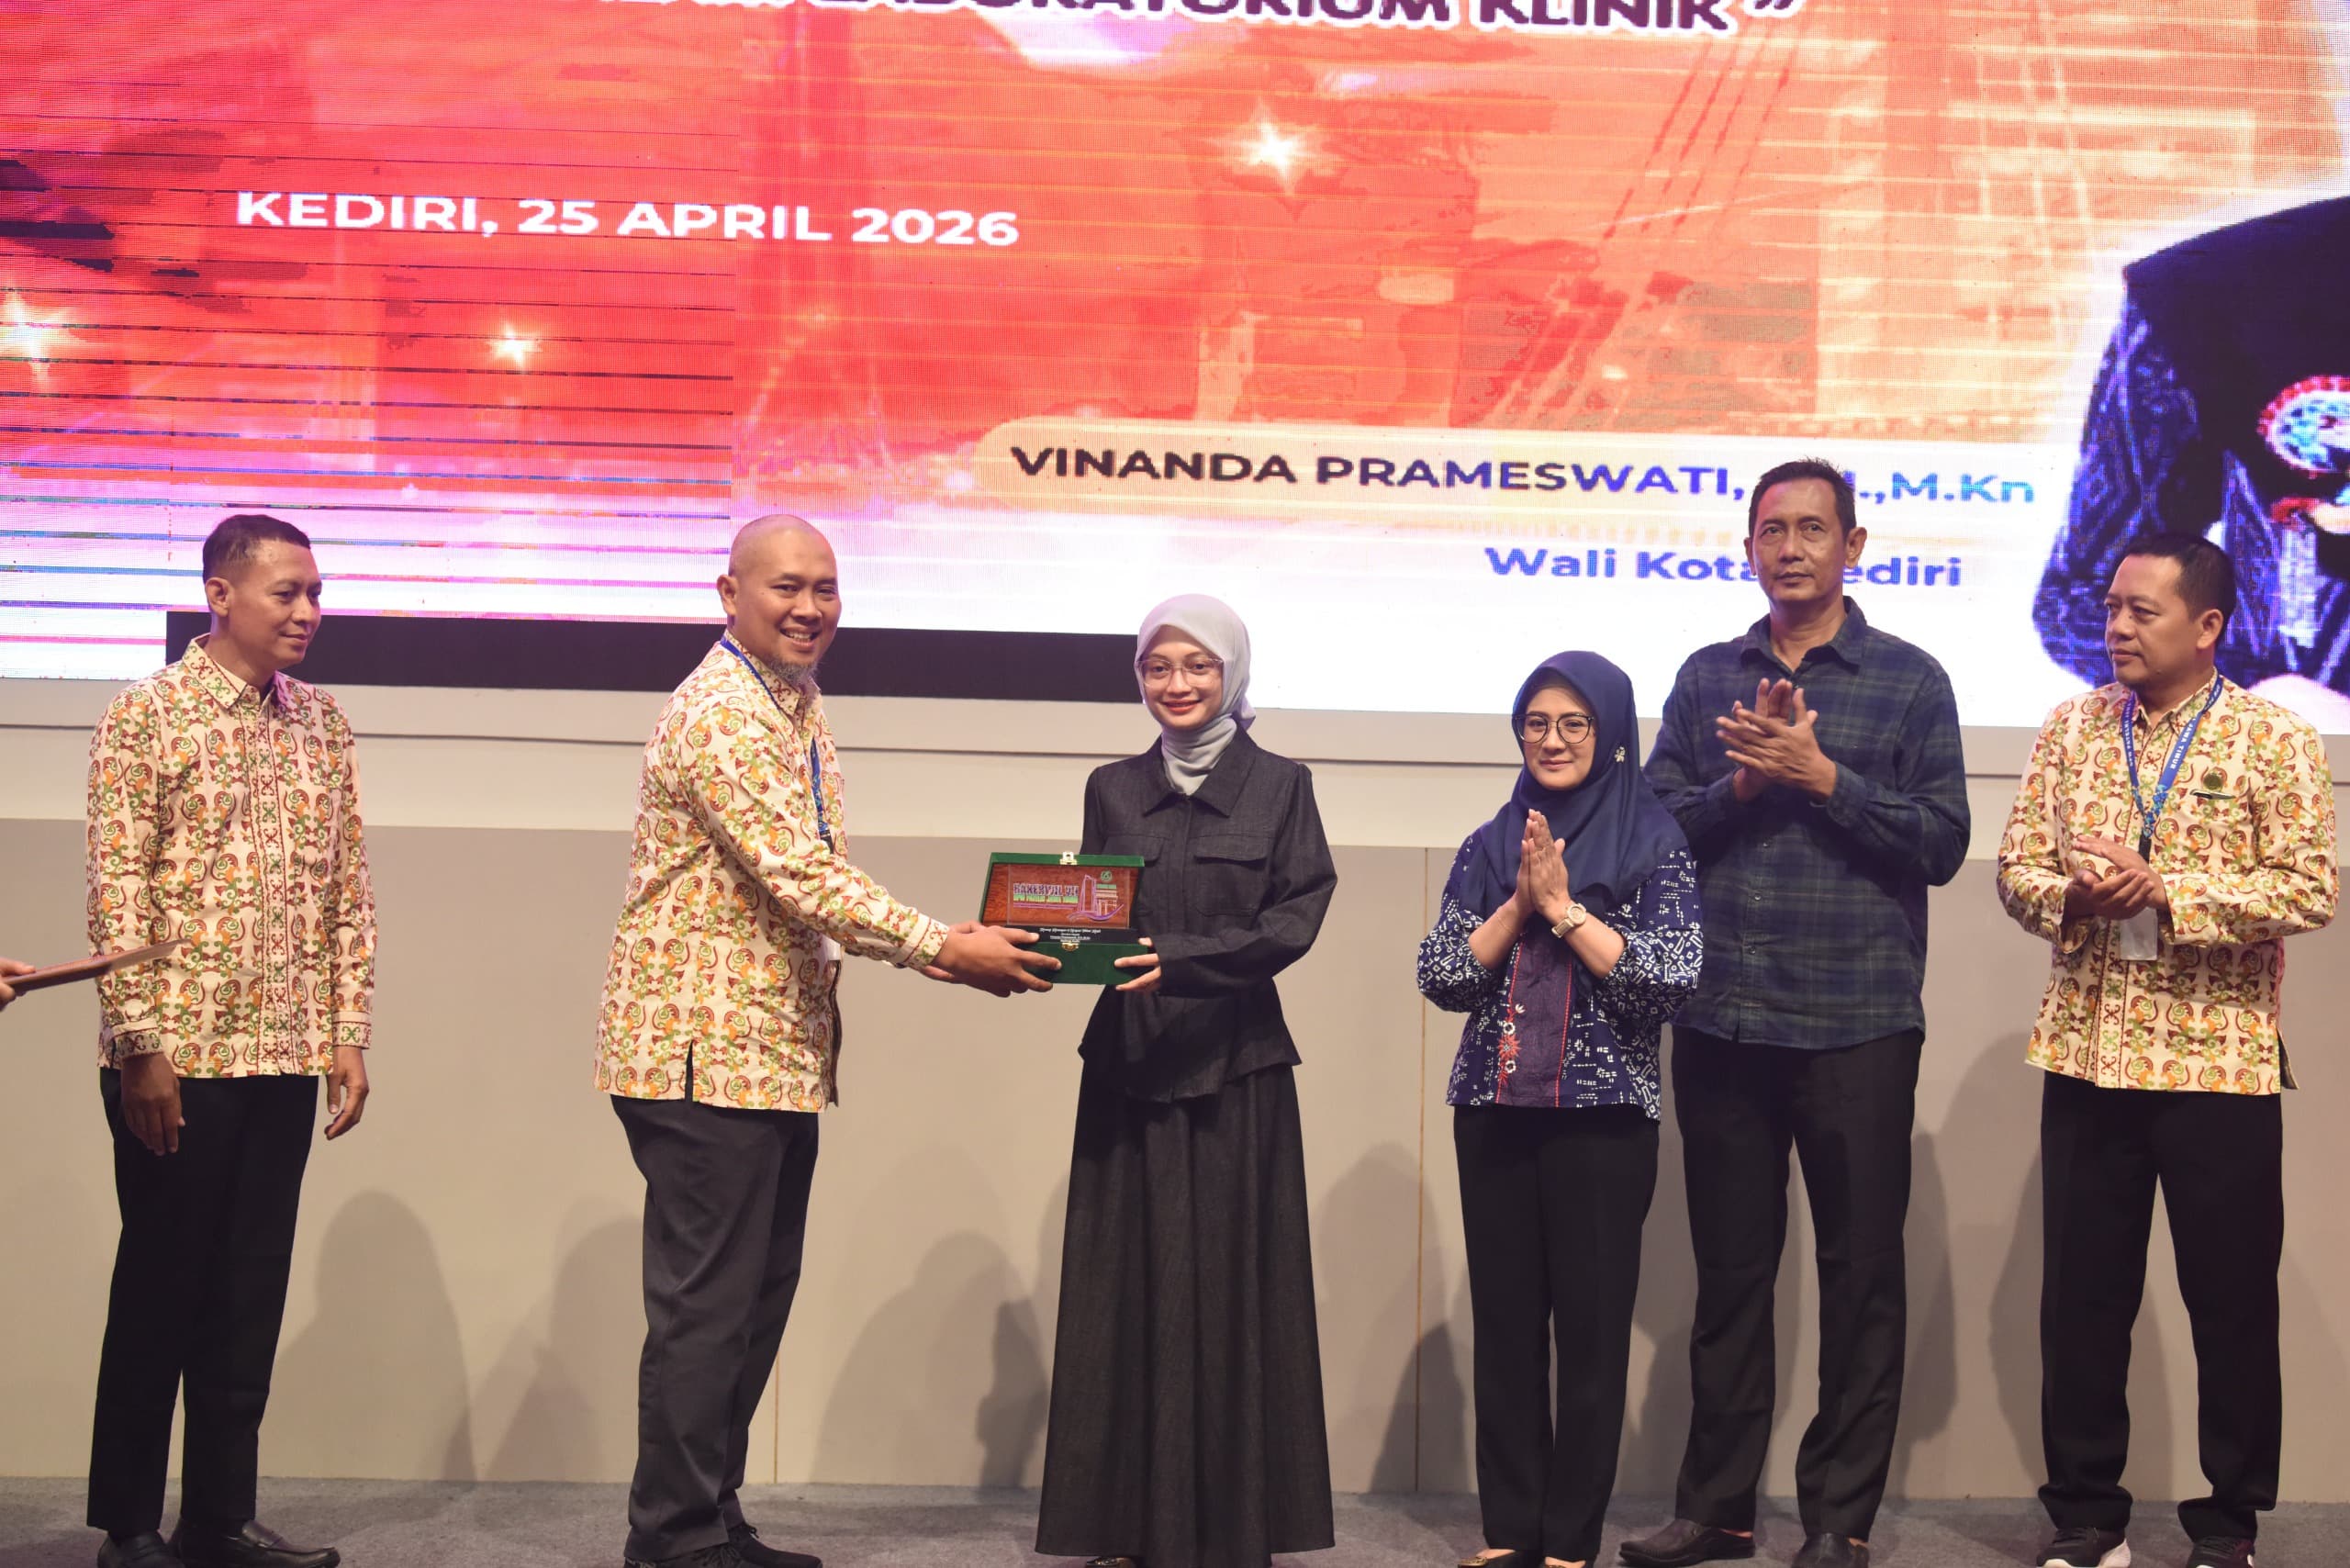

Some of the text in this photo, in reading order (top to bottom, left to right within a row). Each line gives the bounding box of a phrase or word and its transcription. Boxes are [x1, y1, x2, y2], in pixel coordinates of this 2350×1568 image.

[1480, 0, 1728, 30] KLINIK
[238, 191, 1020, 247] KEDIRI, 25 APRIL 2026
[1010, 445, 1298, 484] VINANDA
[1315, 455, 1745, 500] PRAMESWATI,
[1484, 547, 1617, 577] Wali
[1843, 554, 1963, 587] ediri
[2170, 722, 2195, 769] JAWA TIMUR
